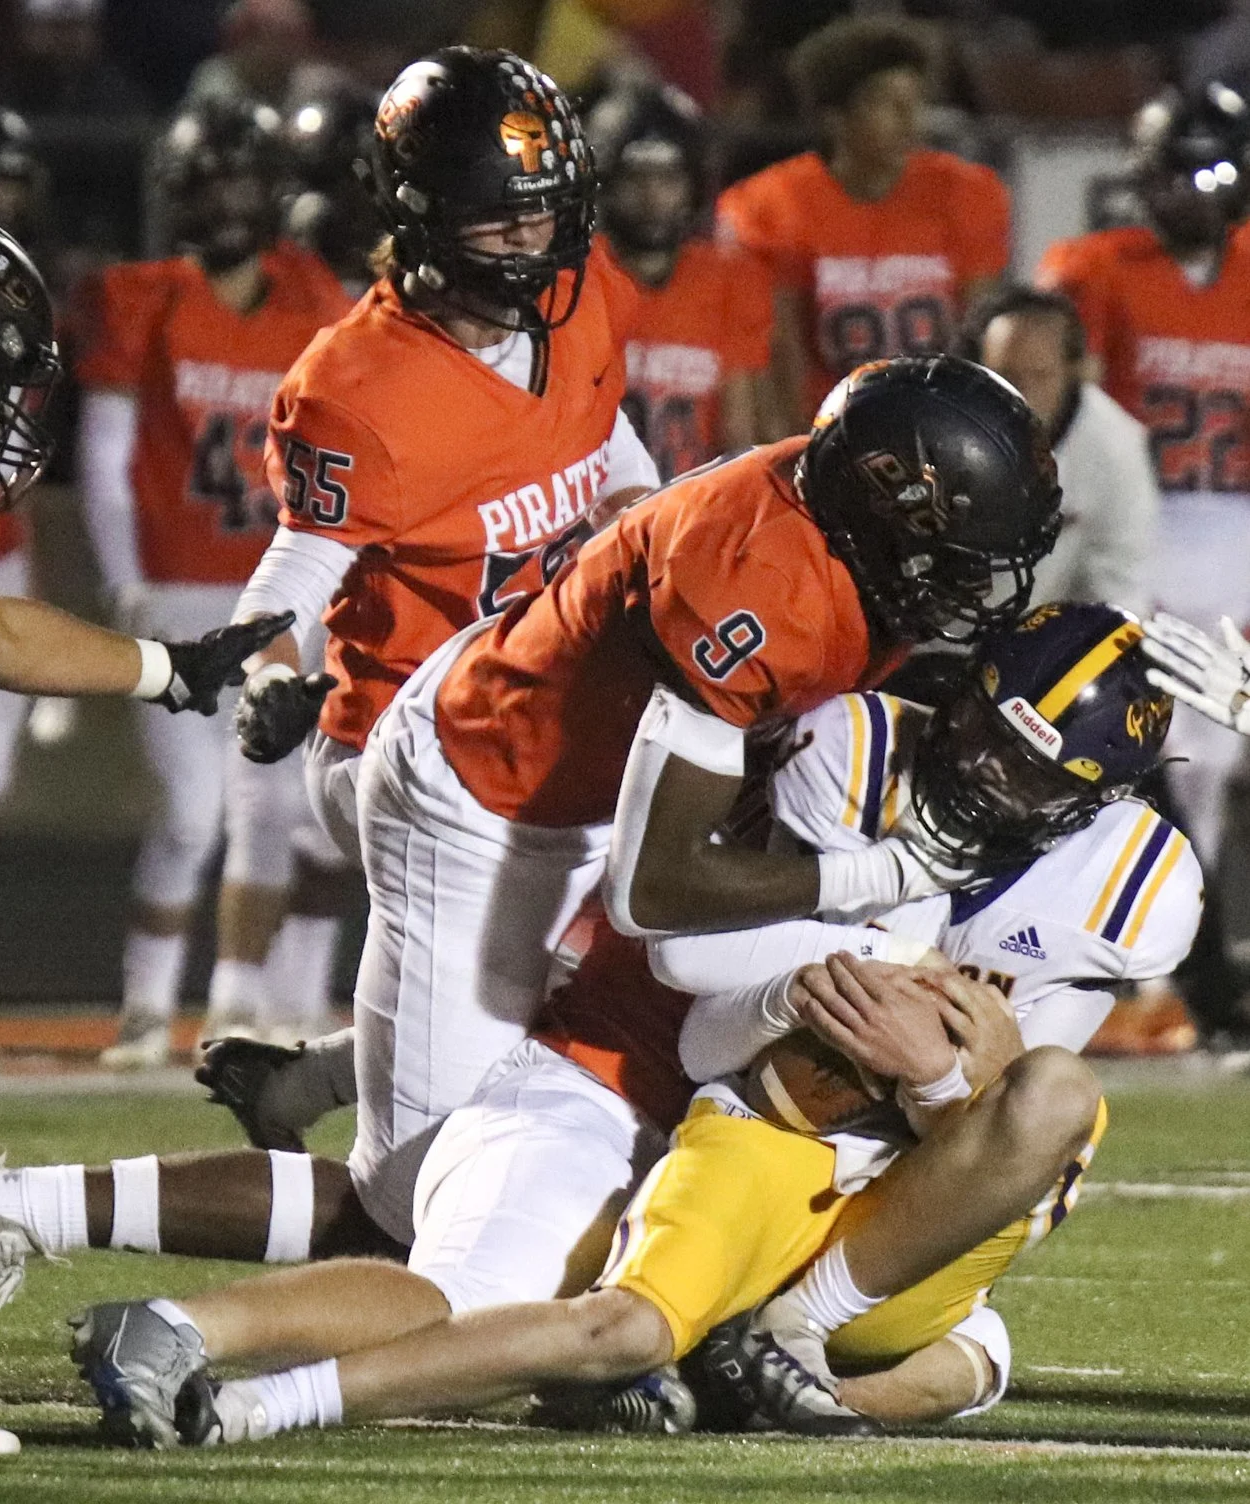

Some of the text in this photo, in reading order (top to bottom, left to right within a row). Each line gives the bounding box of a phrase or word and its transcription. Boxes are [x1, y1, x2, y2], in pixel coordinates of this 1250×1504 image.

[284, 439, 353, 526] 55
[692, 609, 766, 682] 9
[1011, 701, 1057, 746] Riddell
[999, 939, 1047, 960] adidas
